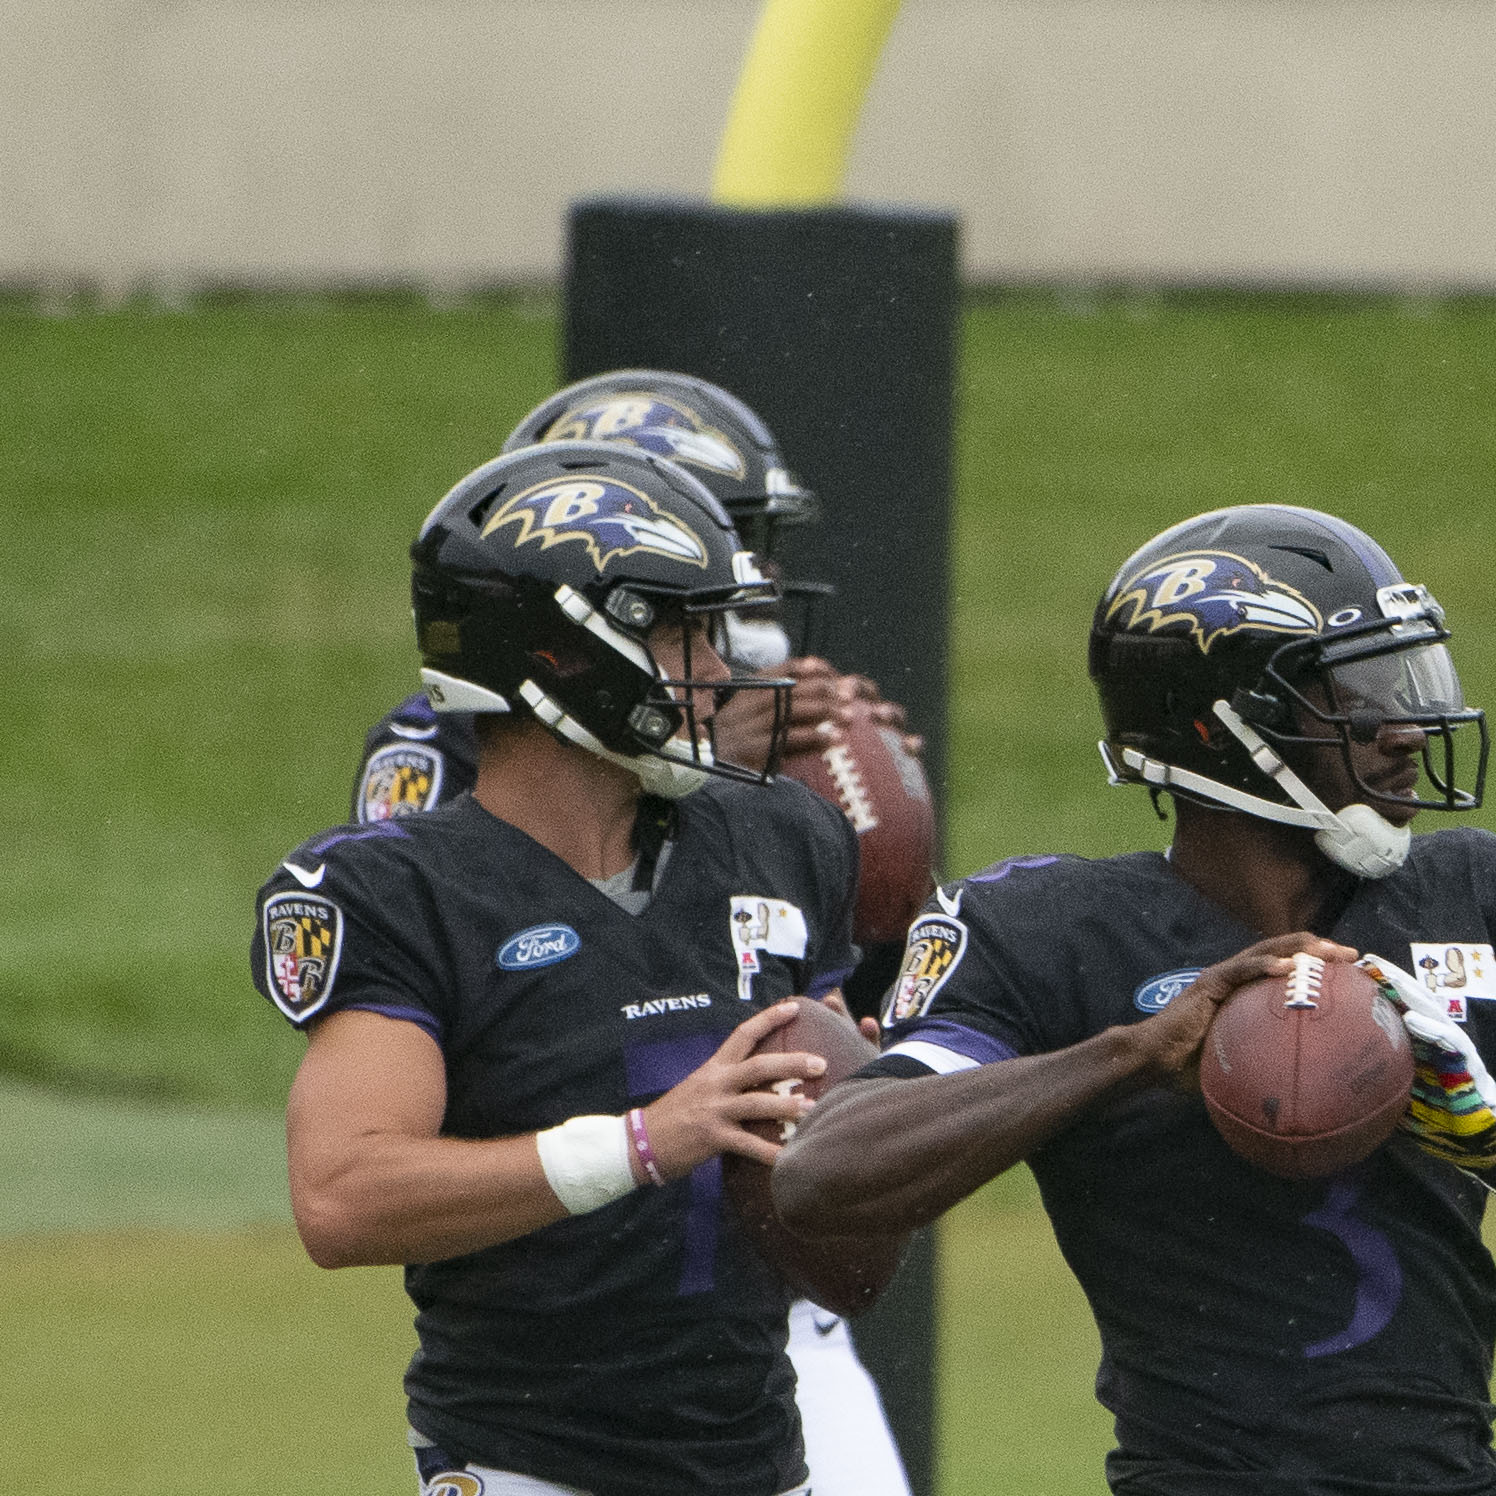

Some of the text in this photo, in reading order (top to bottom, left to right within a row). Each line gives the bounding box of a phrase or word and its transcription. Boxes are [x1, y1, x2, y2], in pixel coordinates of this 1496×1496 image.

[526, 482, 605, 527] B
[1143, 558, 1217, 608] B
[268, 903, 329, 920] RAVENS
[621, 994, 711, 1020] RAVENS
